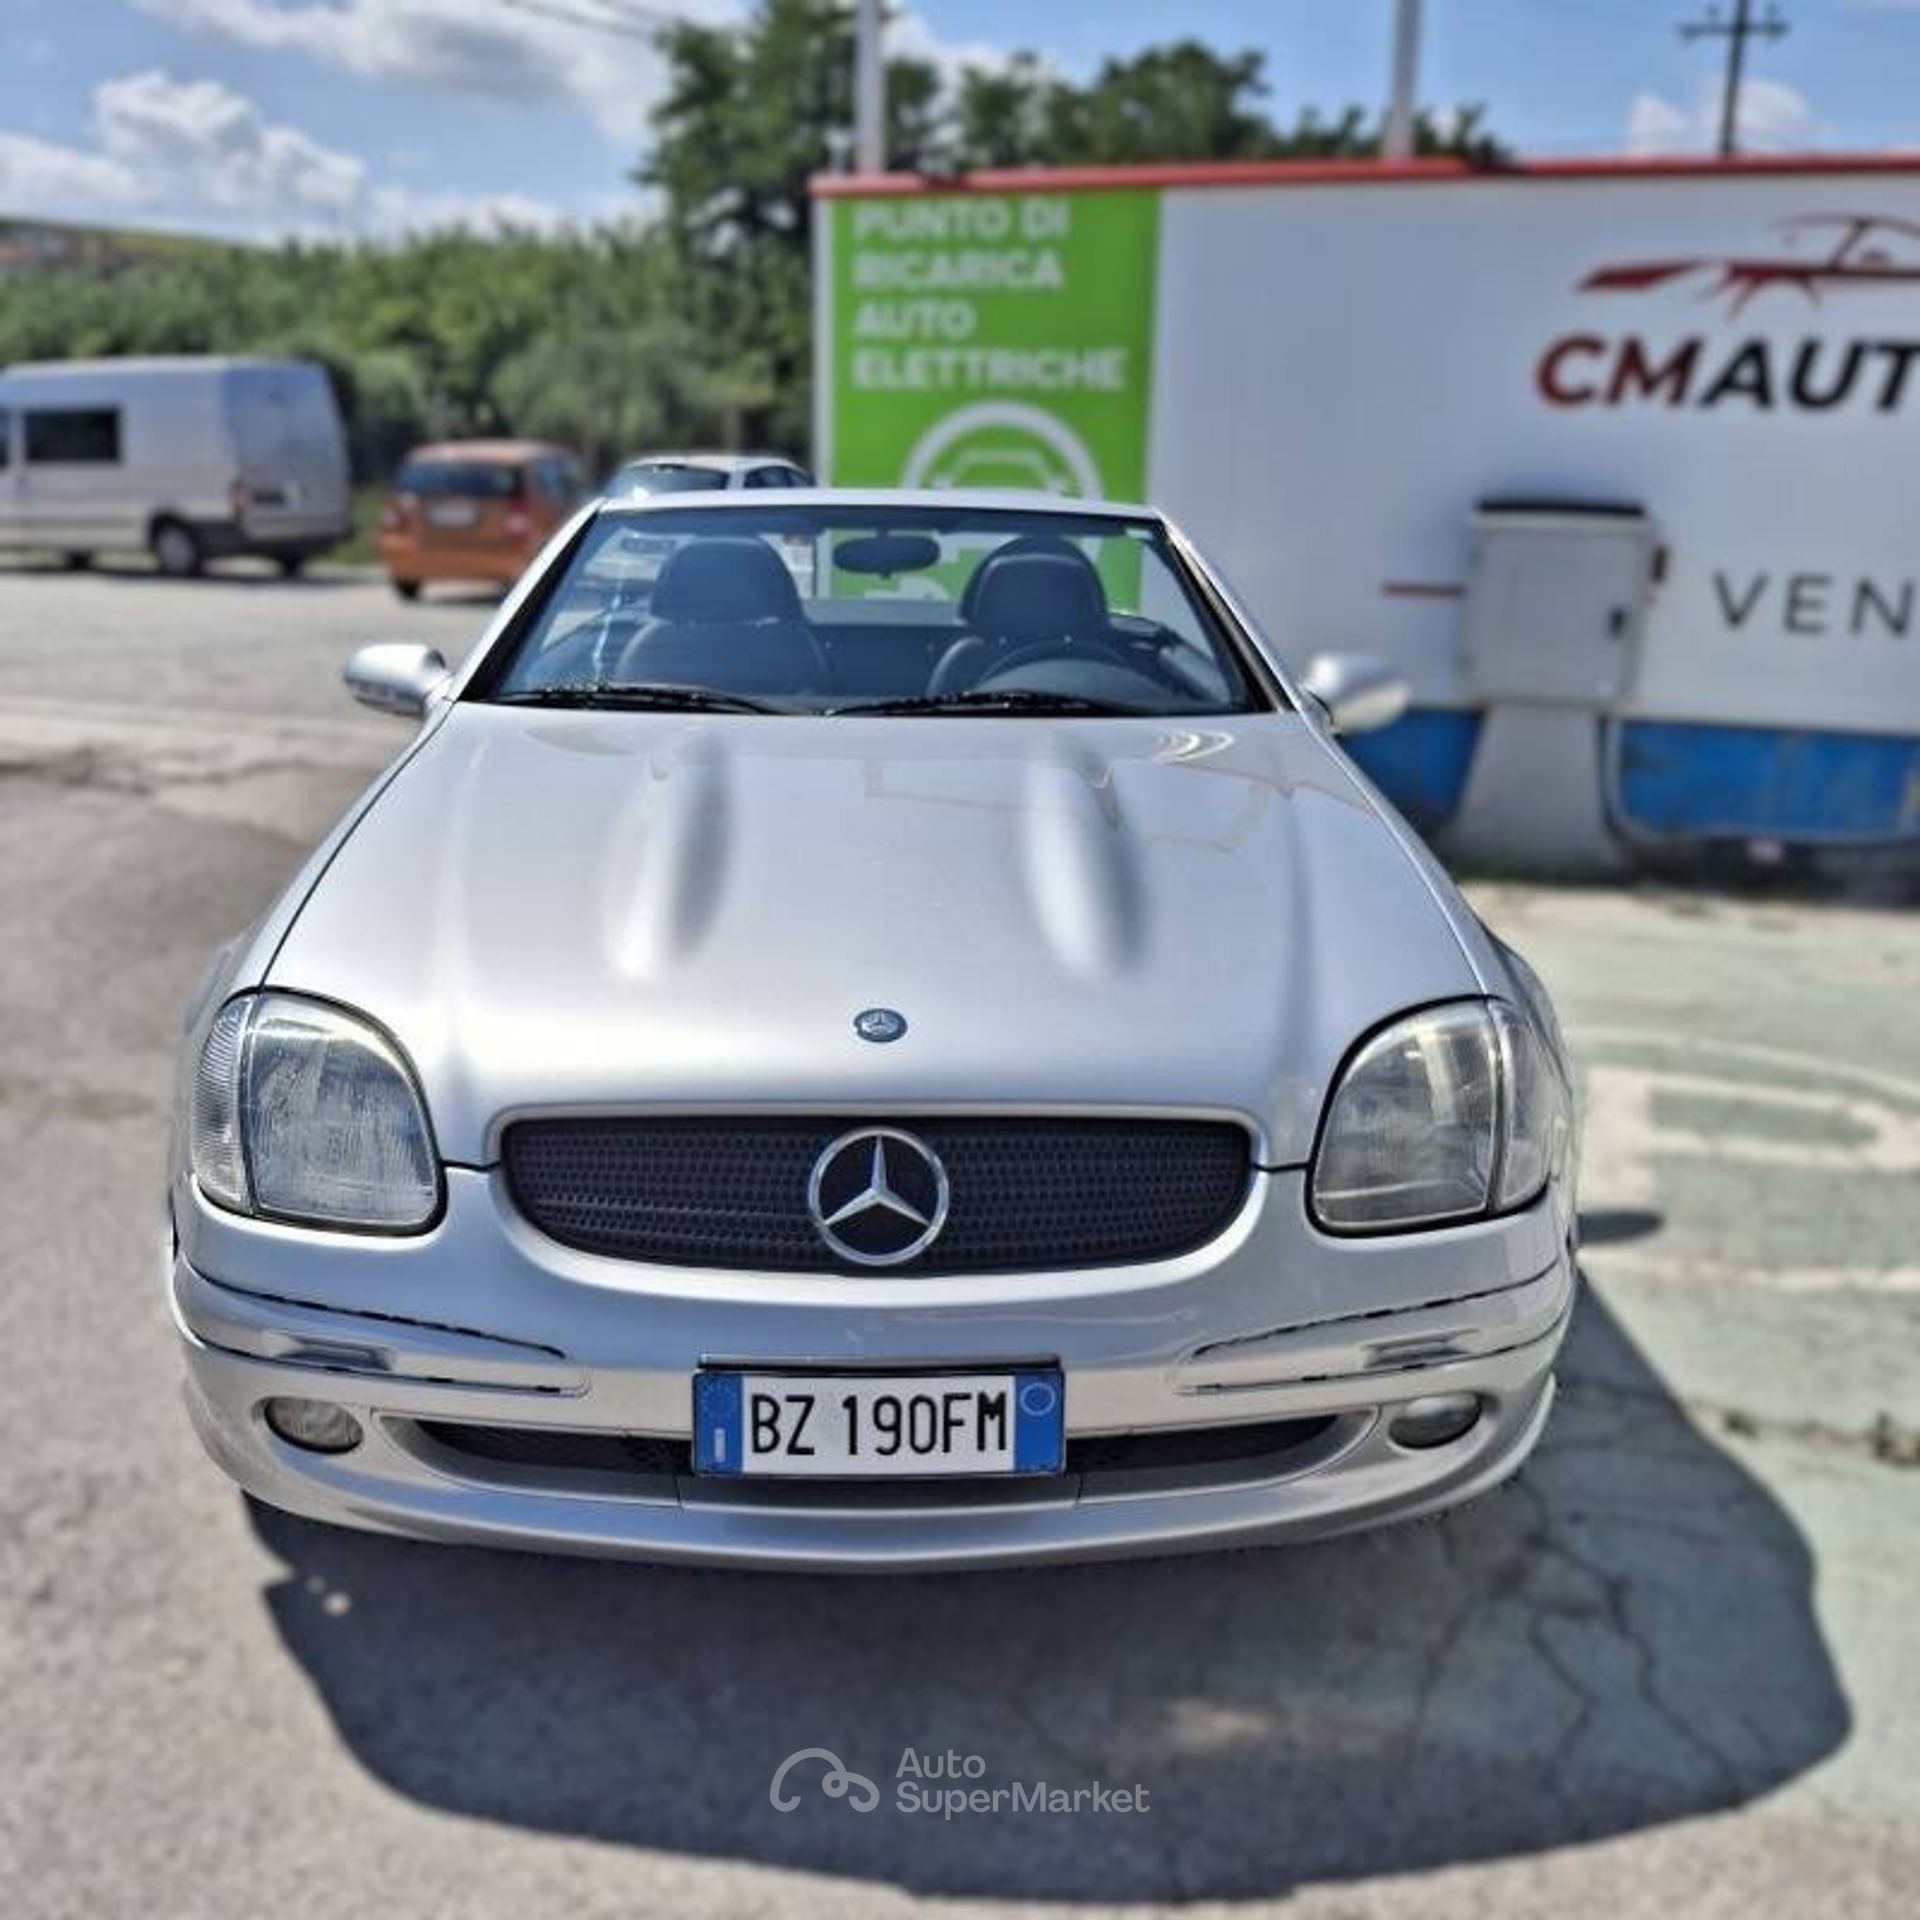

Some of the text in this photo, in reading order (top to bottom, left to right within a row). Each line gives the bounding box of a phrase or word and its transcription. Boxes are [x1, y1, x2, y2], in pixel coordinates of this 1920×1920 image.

[853, 200, 1070, 241] PUNTO DI
[853, 248, 1065, 289] RICARICA
[854, 300, 977, 339] AUTO
[853, 347, 1127, 391] ELETTRICHE
[1712, 570, 1916, 638] VEN
[750, 1391, 1007, 1455] BZ 190FM
